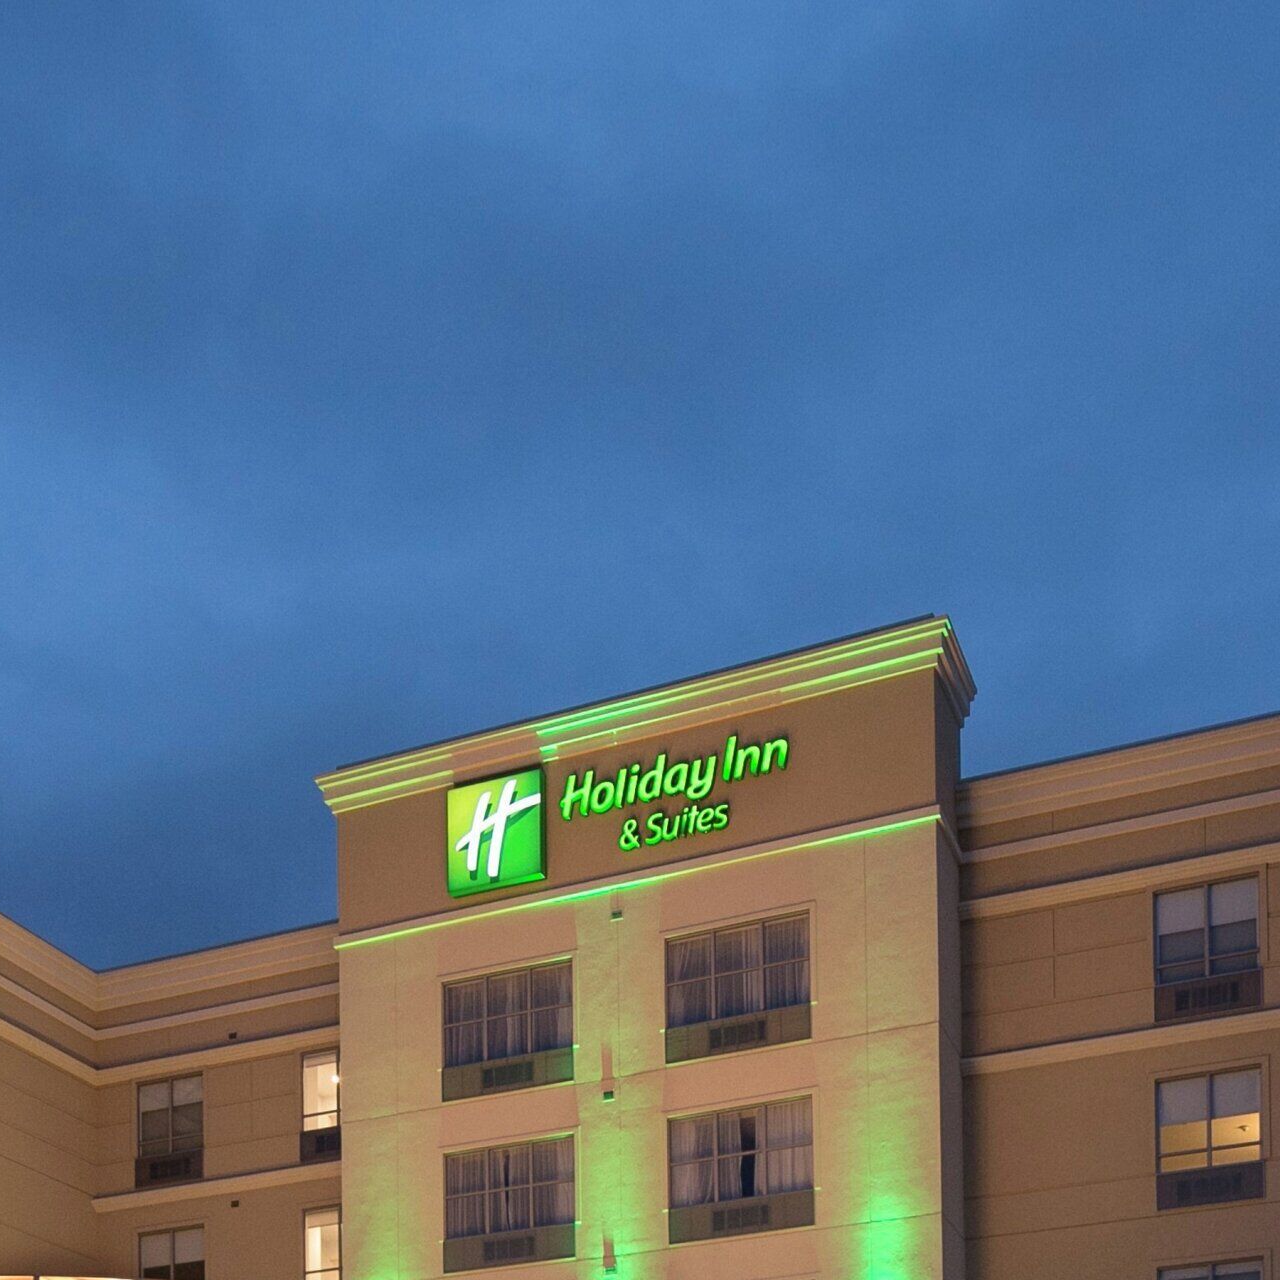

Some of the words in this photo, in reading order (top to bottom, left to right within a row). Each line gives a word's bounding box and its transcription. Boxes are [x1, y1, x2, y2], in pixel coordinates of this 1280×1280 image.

[559, 753, 717, 821] Holiday
[722, 735, 788, 781] Inn
[618, 818, 642, 851] &
[644, 803, 730, 846] Suites
